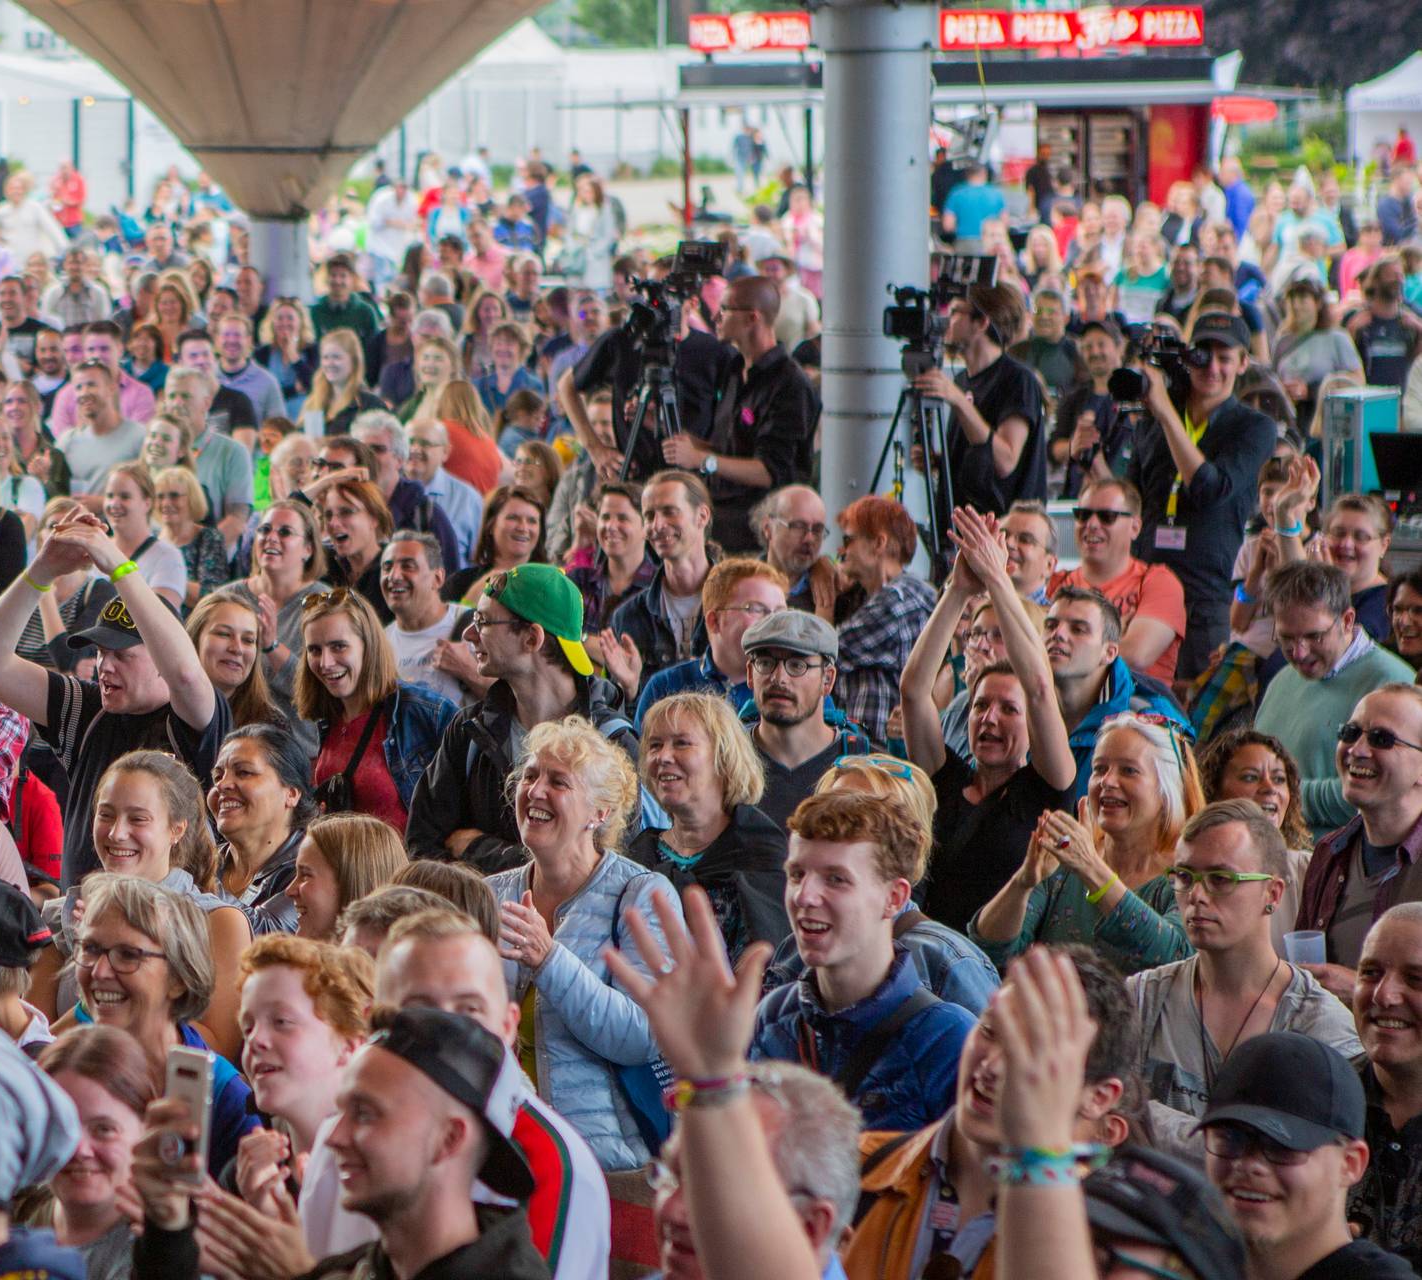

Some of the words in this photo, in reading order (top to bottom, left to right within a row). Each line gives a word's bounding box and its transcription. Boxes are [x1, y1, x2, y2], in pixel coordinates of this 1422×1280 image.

[944, 14, 1006, 45] PIZZA
[1012, 14, 1073, 44] PIZZA
[1141, 10, 1202, 42] PIZZA
